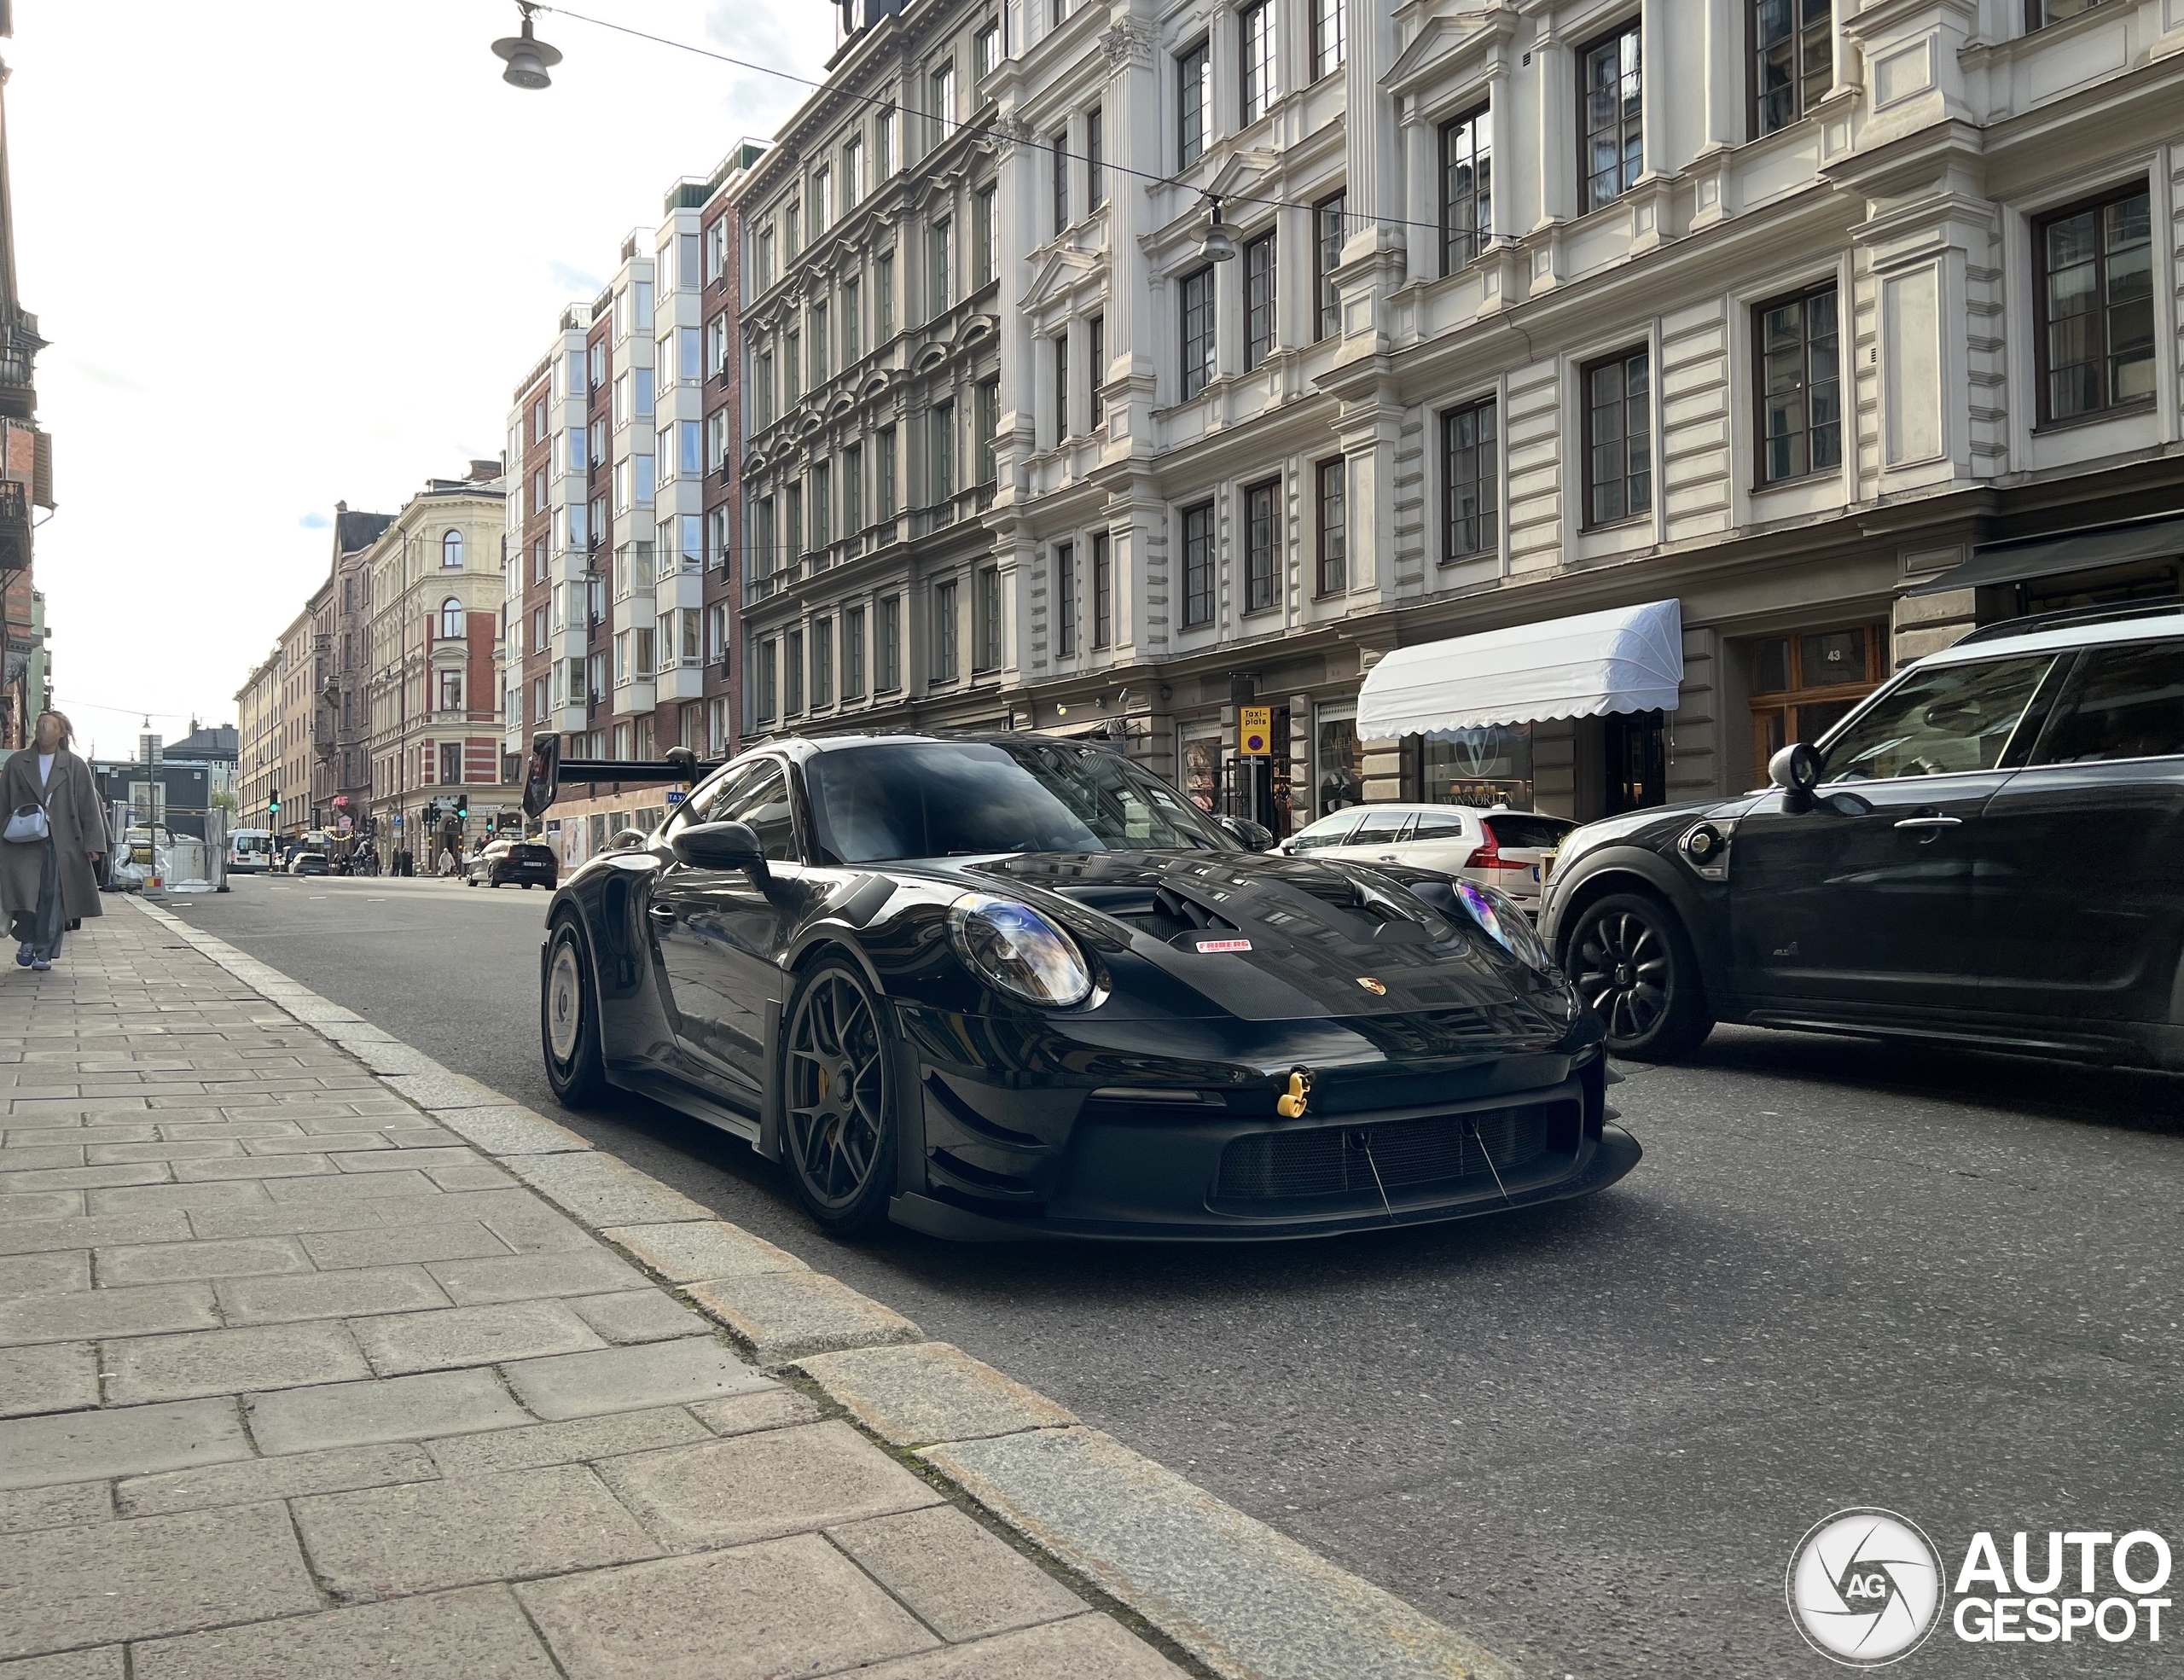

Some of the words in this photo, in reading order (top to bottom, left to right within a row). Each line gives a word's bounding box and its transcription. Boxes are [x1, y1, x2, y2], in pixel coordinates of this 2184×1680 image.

[1827, 649, 1841, 661] 43
[1245, 718, 1267, 727] plats
[1443, 795, 1466, 805] VON
[1467, 792, 1514, 806] NORTEN
